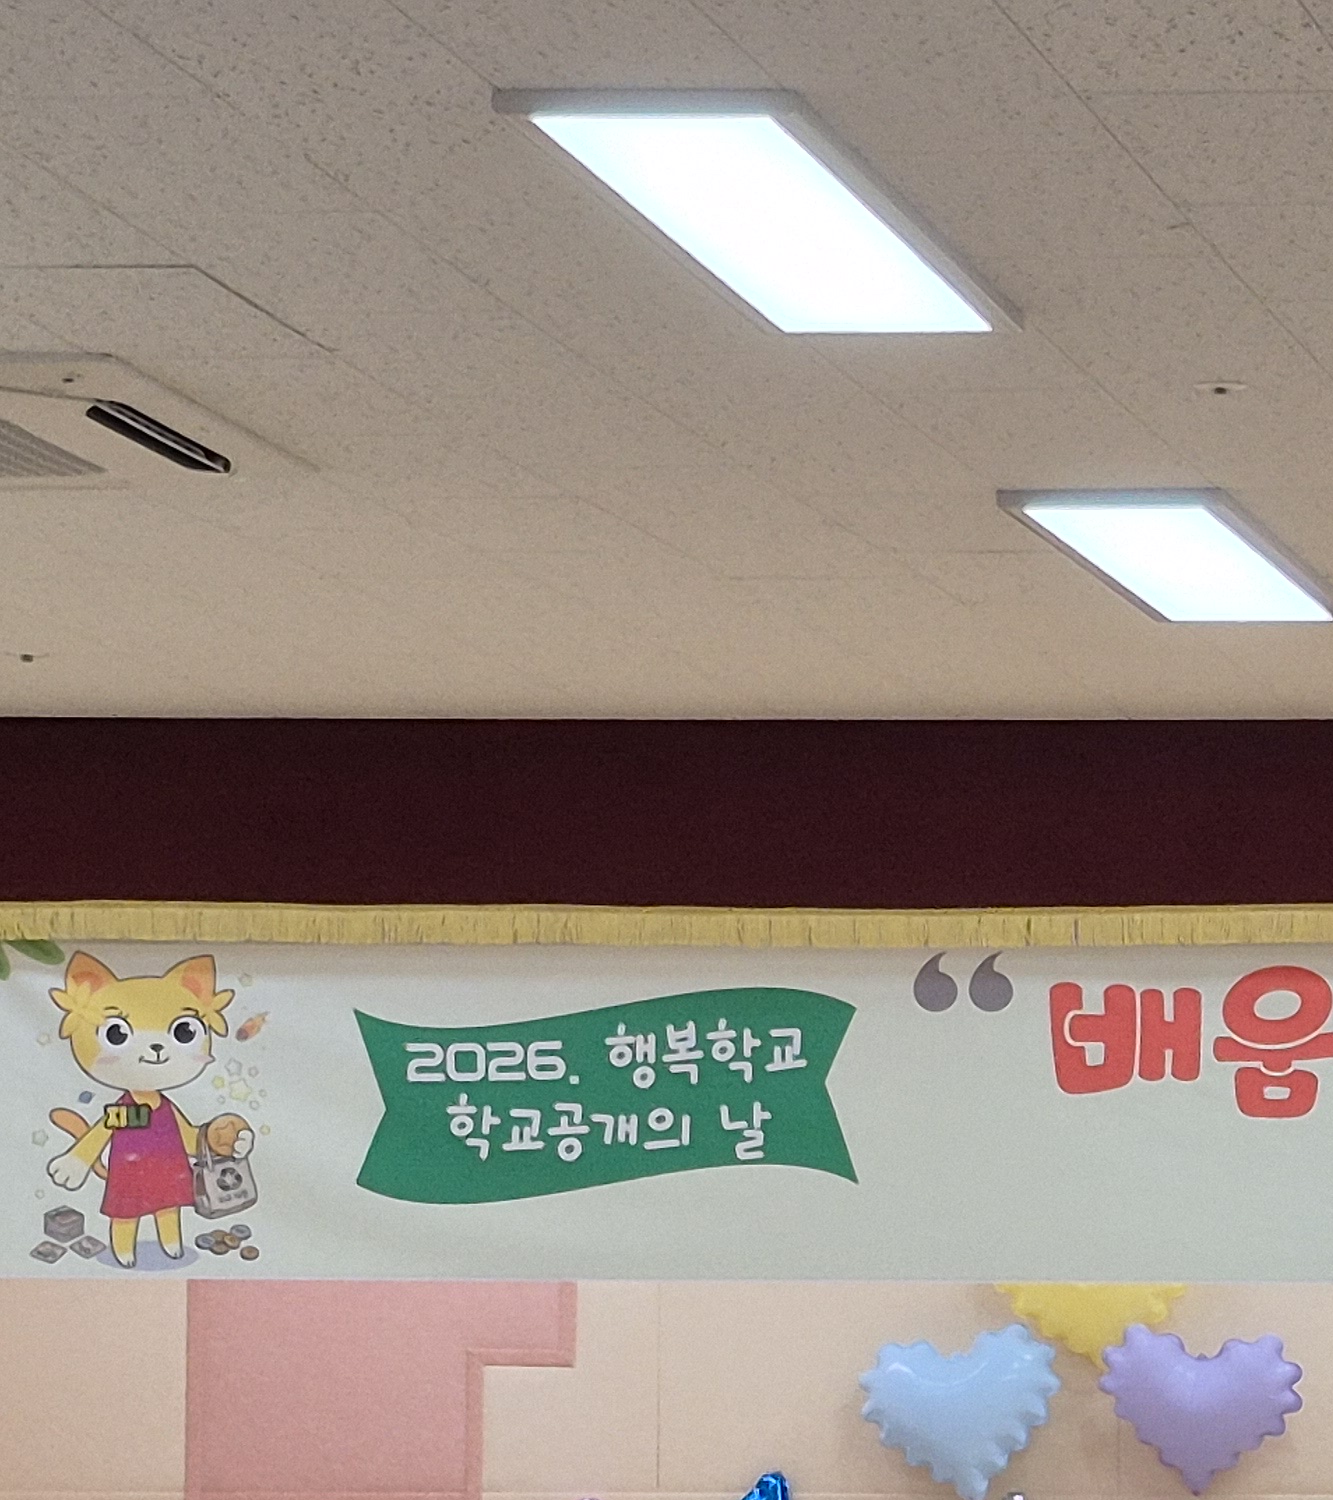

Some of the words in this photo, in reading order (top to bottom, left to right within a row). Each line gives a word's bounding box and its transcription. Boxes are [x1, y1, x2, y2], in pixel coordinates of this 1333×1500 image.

[404, 1040, 580, 1085] 2026.
[604, 1017, 808, 1089] 행복학교
[445, 1092, 691, 1162] 학교공개의
[719, 1101, 772, 1162] 날
